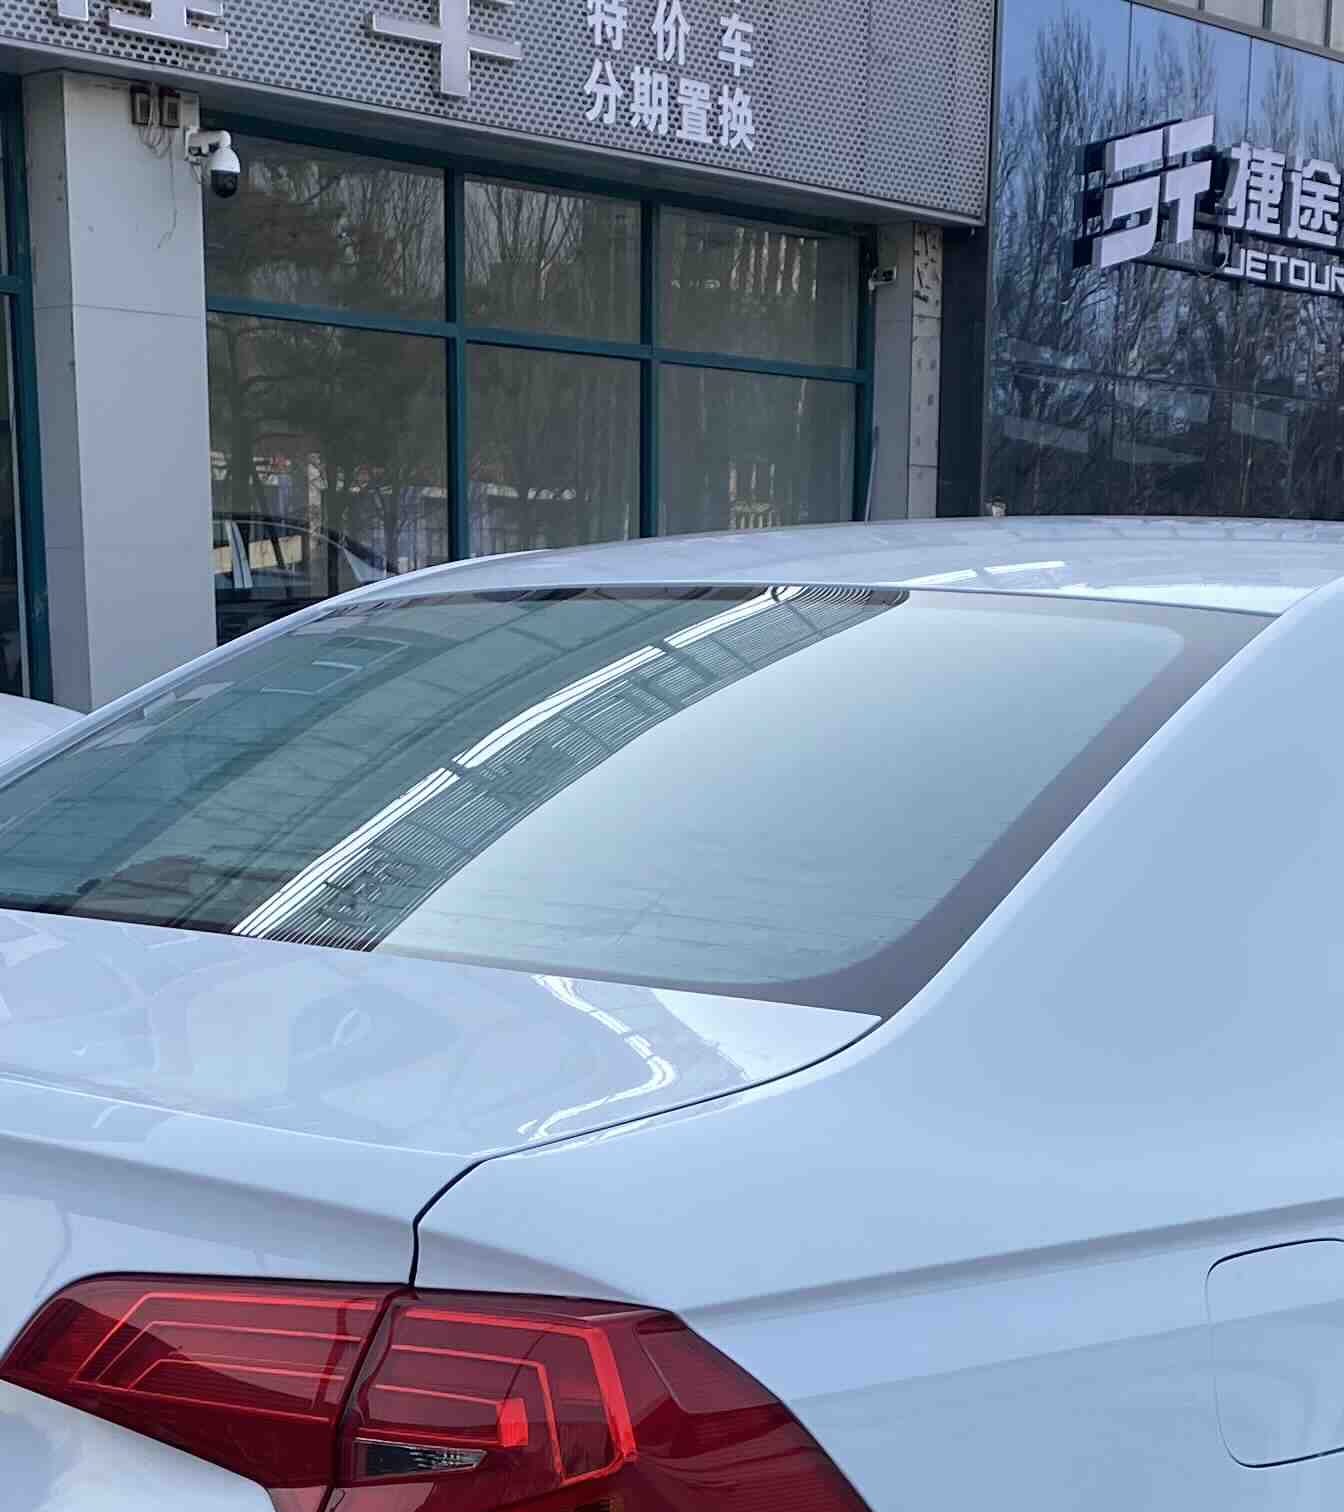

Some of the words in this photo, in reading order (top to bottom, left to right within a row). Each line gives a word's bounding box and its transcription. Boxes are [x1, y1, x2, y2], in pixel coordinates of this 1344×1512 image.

[585, 0, 755, 77] 特价车
[583, 57, 756, 151] 分期置换
